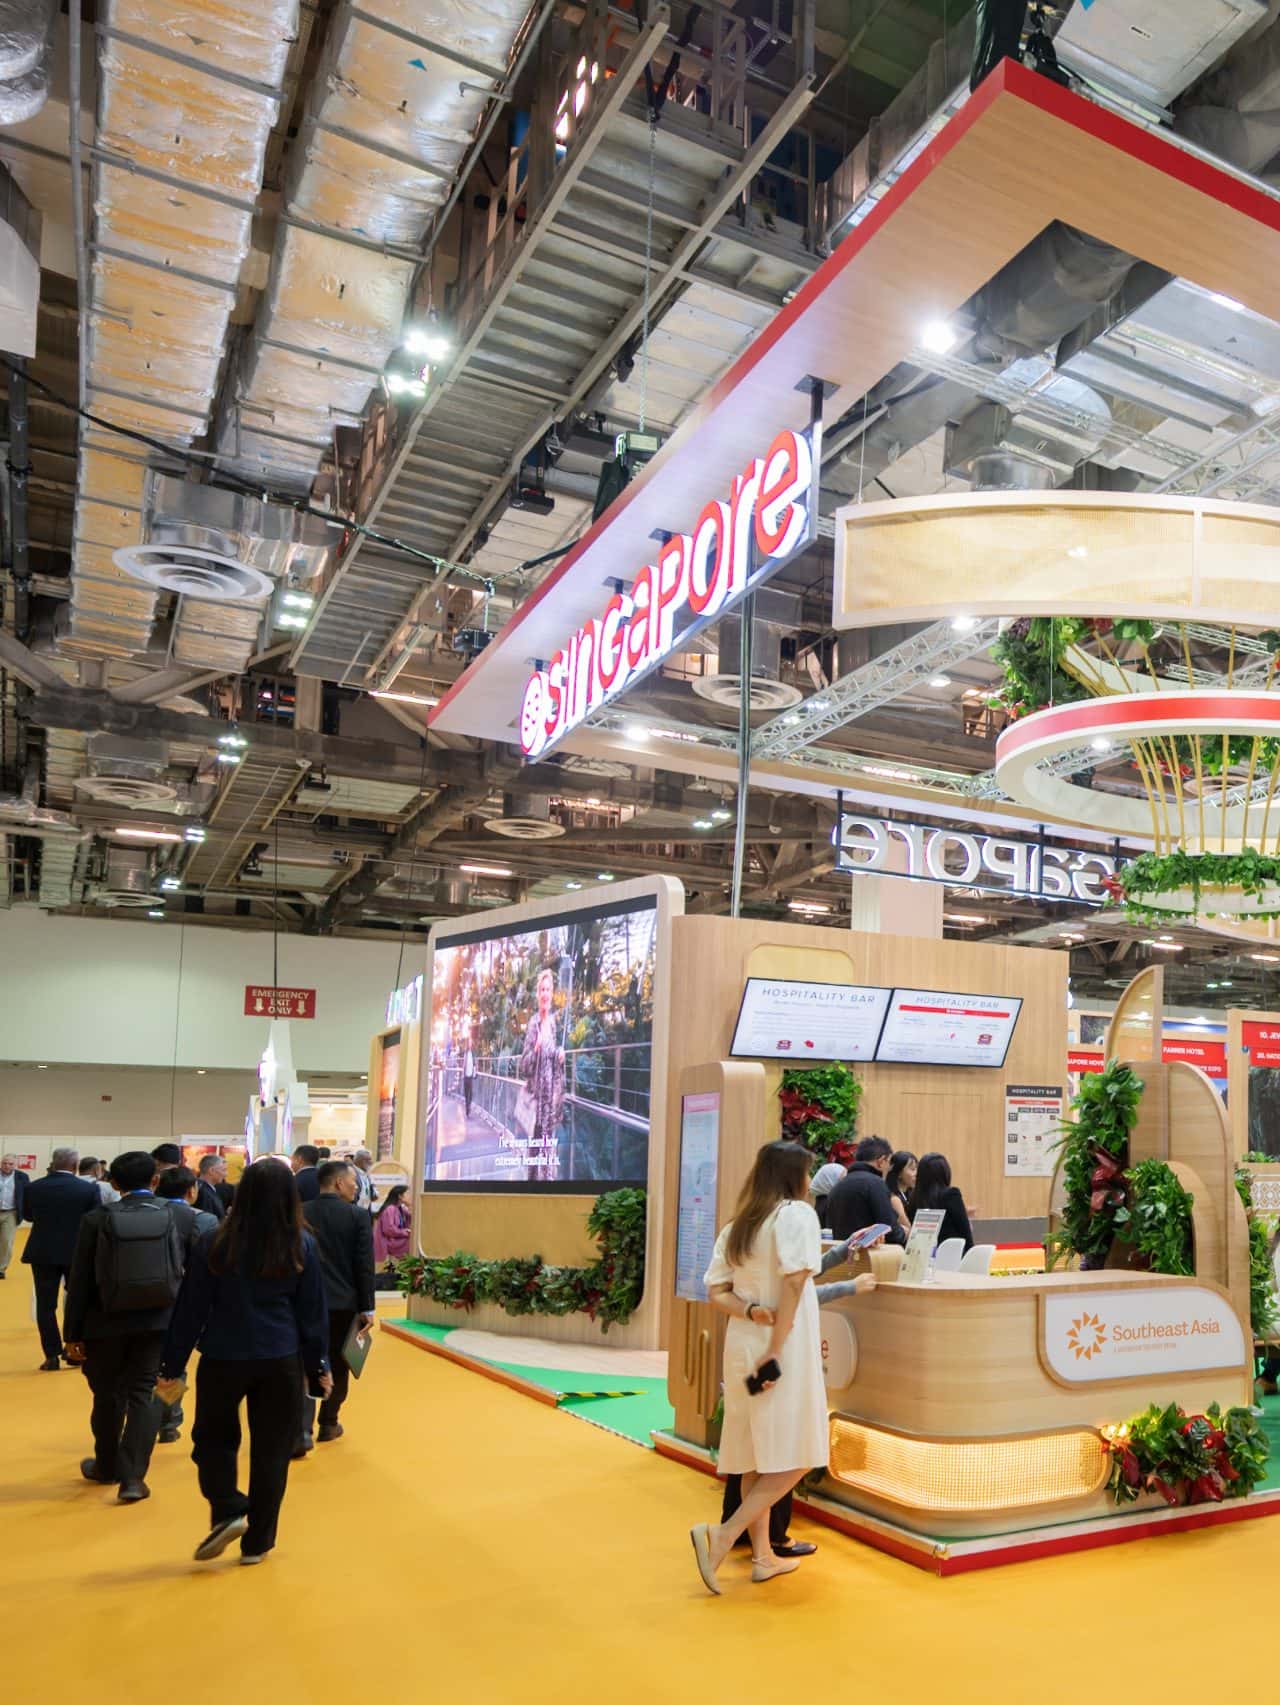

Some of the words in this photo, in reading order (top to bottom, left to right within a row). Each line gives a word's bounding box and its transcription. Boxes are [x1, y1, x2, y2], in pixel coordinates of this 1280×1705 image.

[252, 988, 309, 1000] EMERGENCY
[762, 987, 846, 1002] HOSPITALITY
[850, 993, 876, 1003] BAR
[270, 998, 291, 1007] EXIT
[915, 996, 977, 1008] HOSPITALITY
[980, 1000, 999, 1009] BAR
[267, 1006, 293, 1016] ONLY
[1112, 1321, 1188, 1342] Southeast
[1190, 1318, 1220, 1335] Asia
